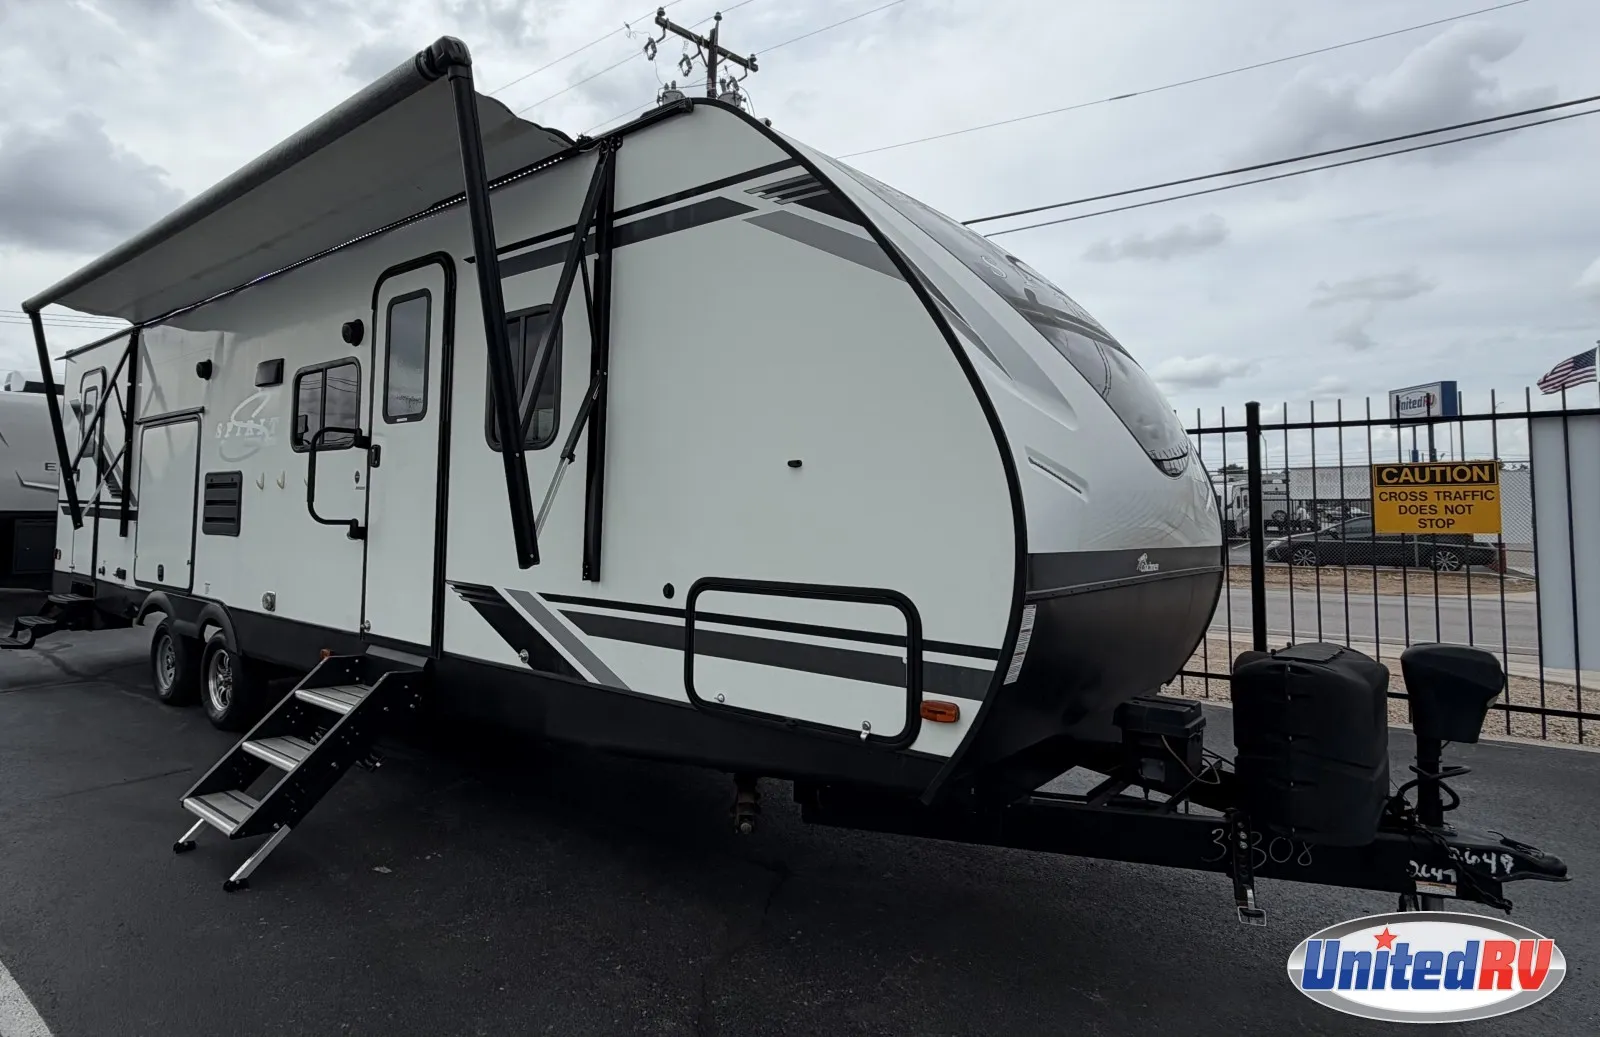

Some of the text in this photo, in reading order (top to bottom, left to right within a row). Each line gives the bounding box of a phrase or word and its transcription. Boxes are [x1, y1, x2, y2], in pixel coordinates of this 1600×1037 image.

[1381, 465, 1490, 484] CAUTION
[1378, 489, 1495, 502] CROSS TRAFFIC
[1398, 504, 1474, 515] DOES NOT
[1418, 518, 1455, 529] STOP
[1201, 828, 1315, 870] 3308
